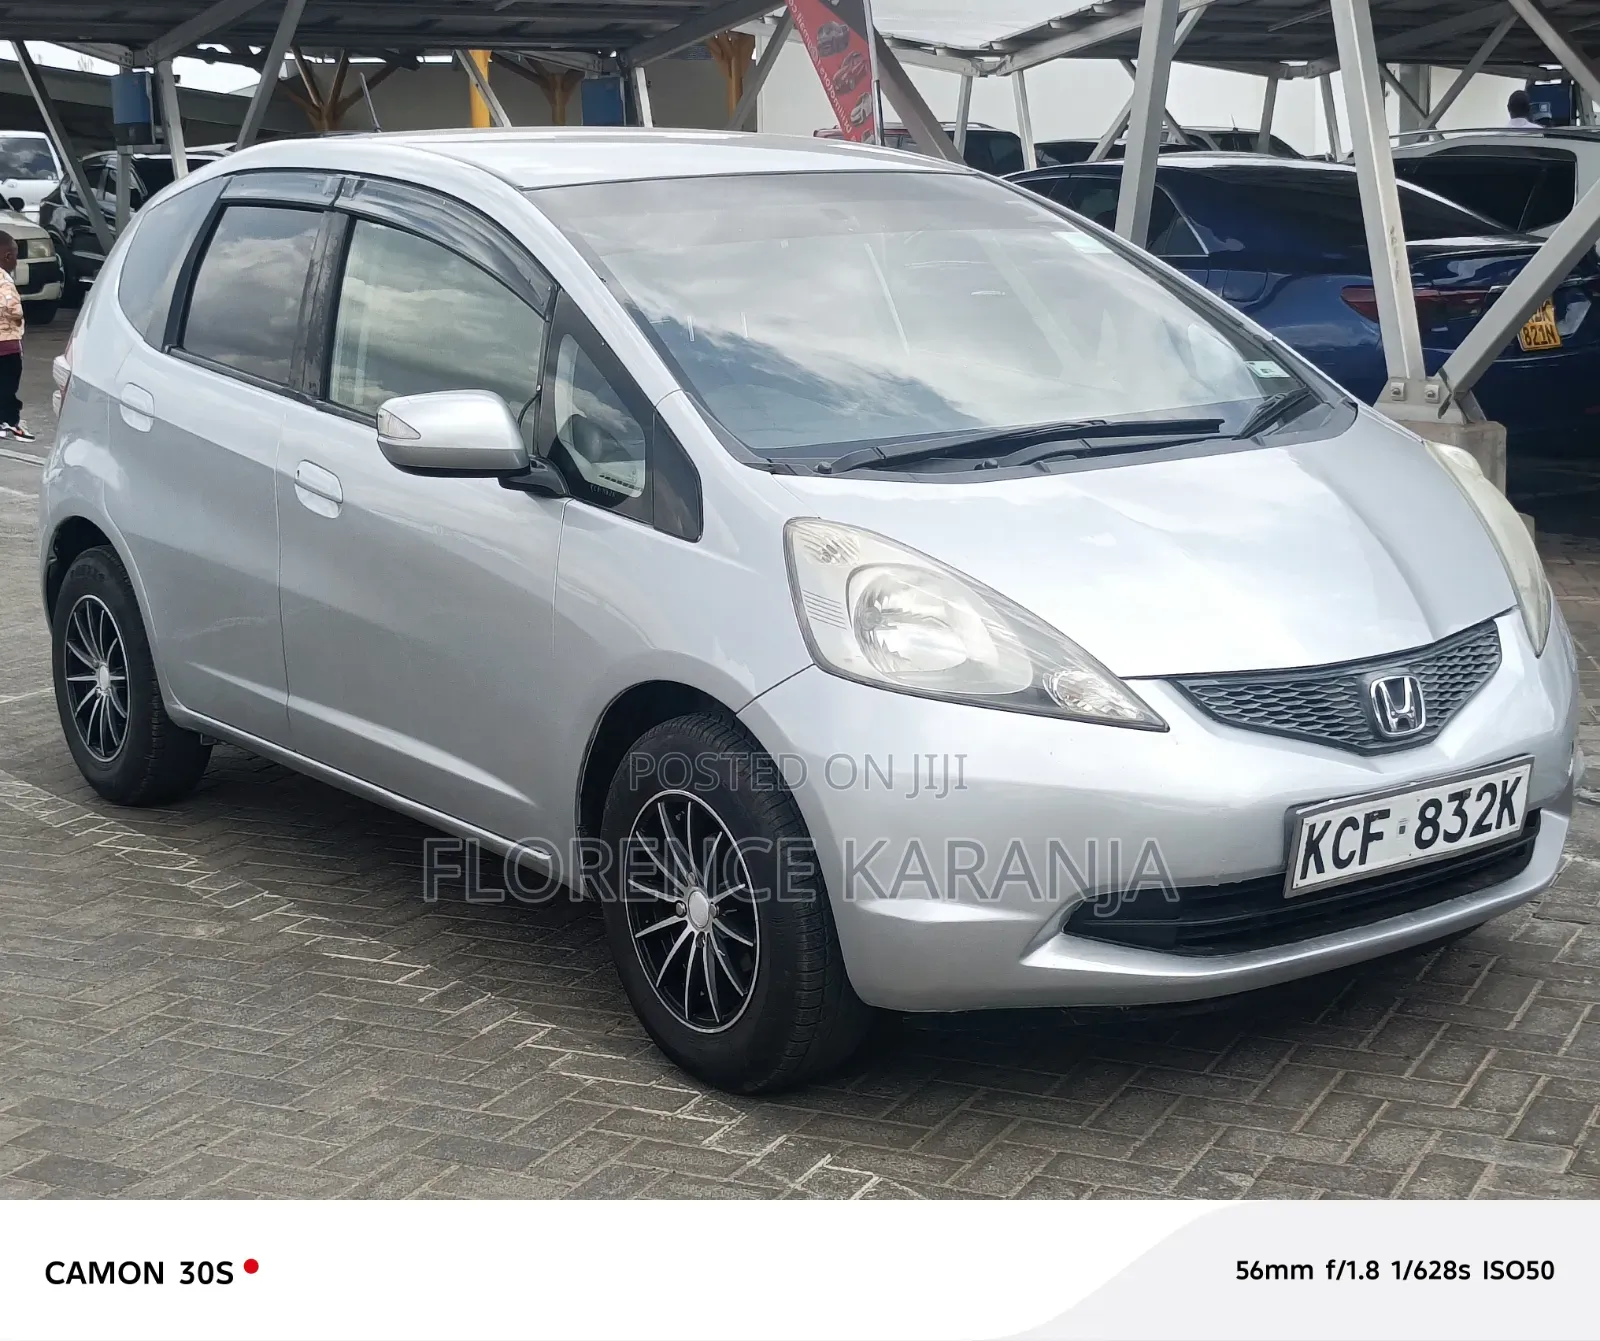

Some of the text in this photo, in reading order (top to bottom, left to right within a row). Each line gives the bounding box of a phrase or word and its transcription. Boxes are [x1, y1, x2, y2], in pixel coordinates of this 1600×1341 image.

[1522, 324, 1557, 346] 821N
[1299, 776, 1523, 880] KCF 832K
